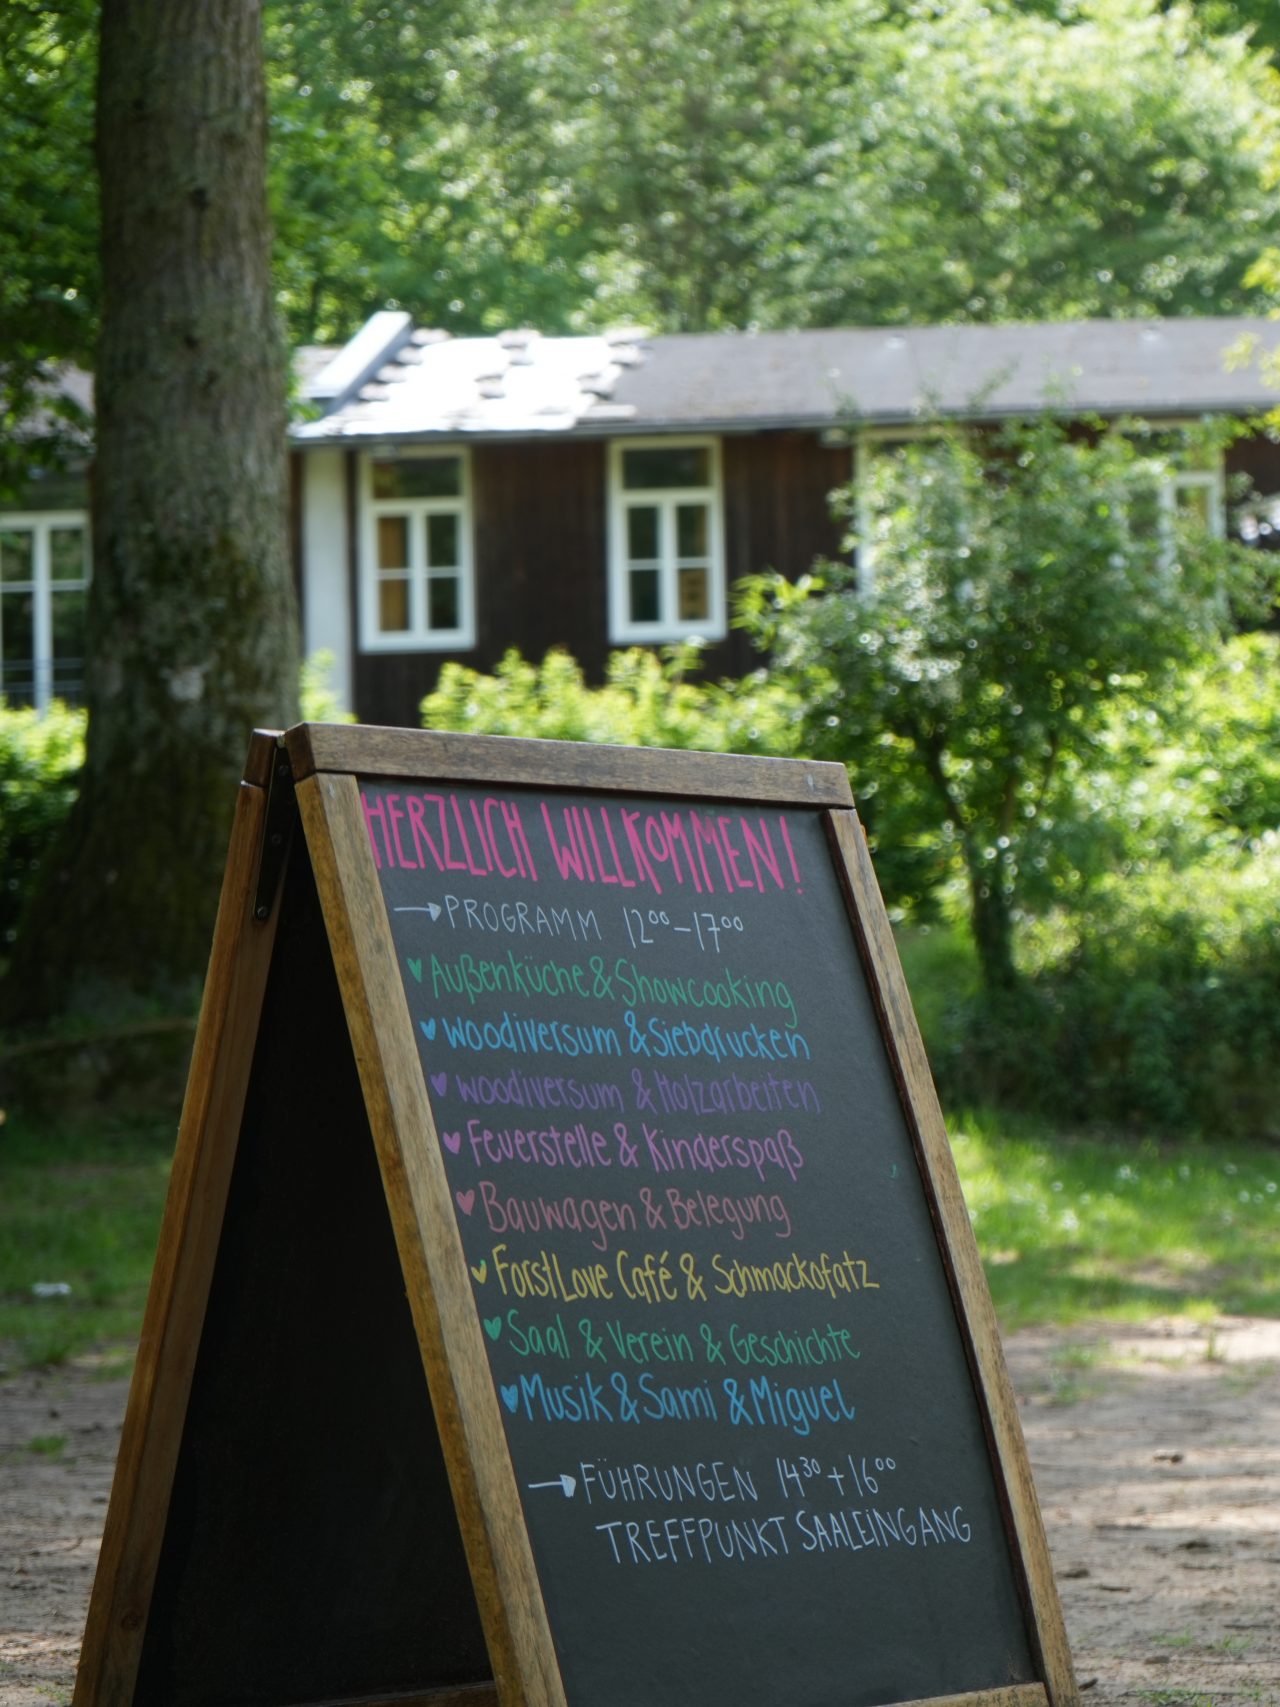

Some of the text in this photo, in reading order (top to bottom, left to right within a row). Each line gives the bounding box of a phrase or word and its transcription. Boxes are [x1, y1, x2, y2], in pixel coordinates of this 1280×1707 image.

[361, 793, 804, 895] HERZLICH WILLKOMMEN!
[445, 895, 602, 940] PROGRAMM
[648, 1020, 810, 1063] Siebdrucken
[653, 1069, 822, 1116] Holzarbeiten
[467, 1119, 804, 1181] Feuerstelle & Kinderspaß
[479, 1181, 792, 1251] Bauwagen & Belegung
[616, 1249, 677, 1304] Café
[680, 1253, 707, 1301] &
[712, 1250, 880, 1299] Schmackofatz
[507, 1309, 861, 1367] Saal & Verein & Geschichte
[520, 1373, 613, 1422] Musik
[638, 1373, 718, 1421] Sami
[749, 1375, 856, 1435] Miguel
[580, 1457, 759, 1505] FÜHRUNGEN
[596, 1515, 789, 1564] TREFFPUNKT
